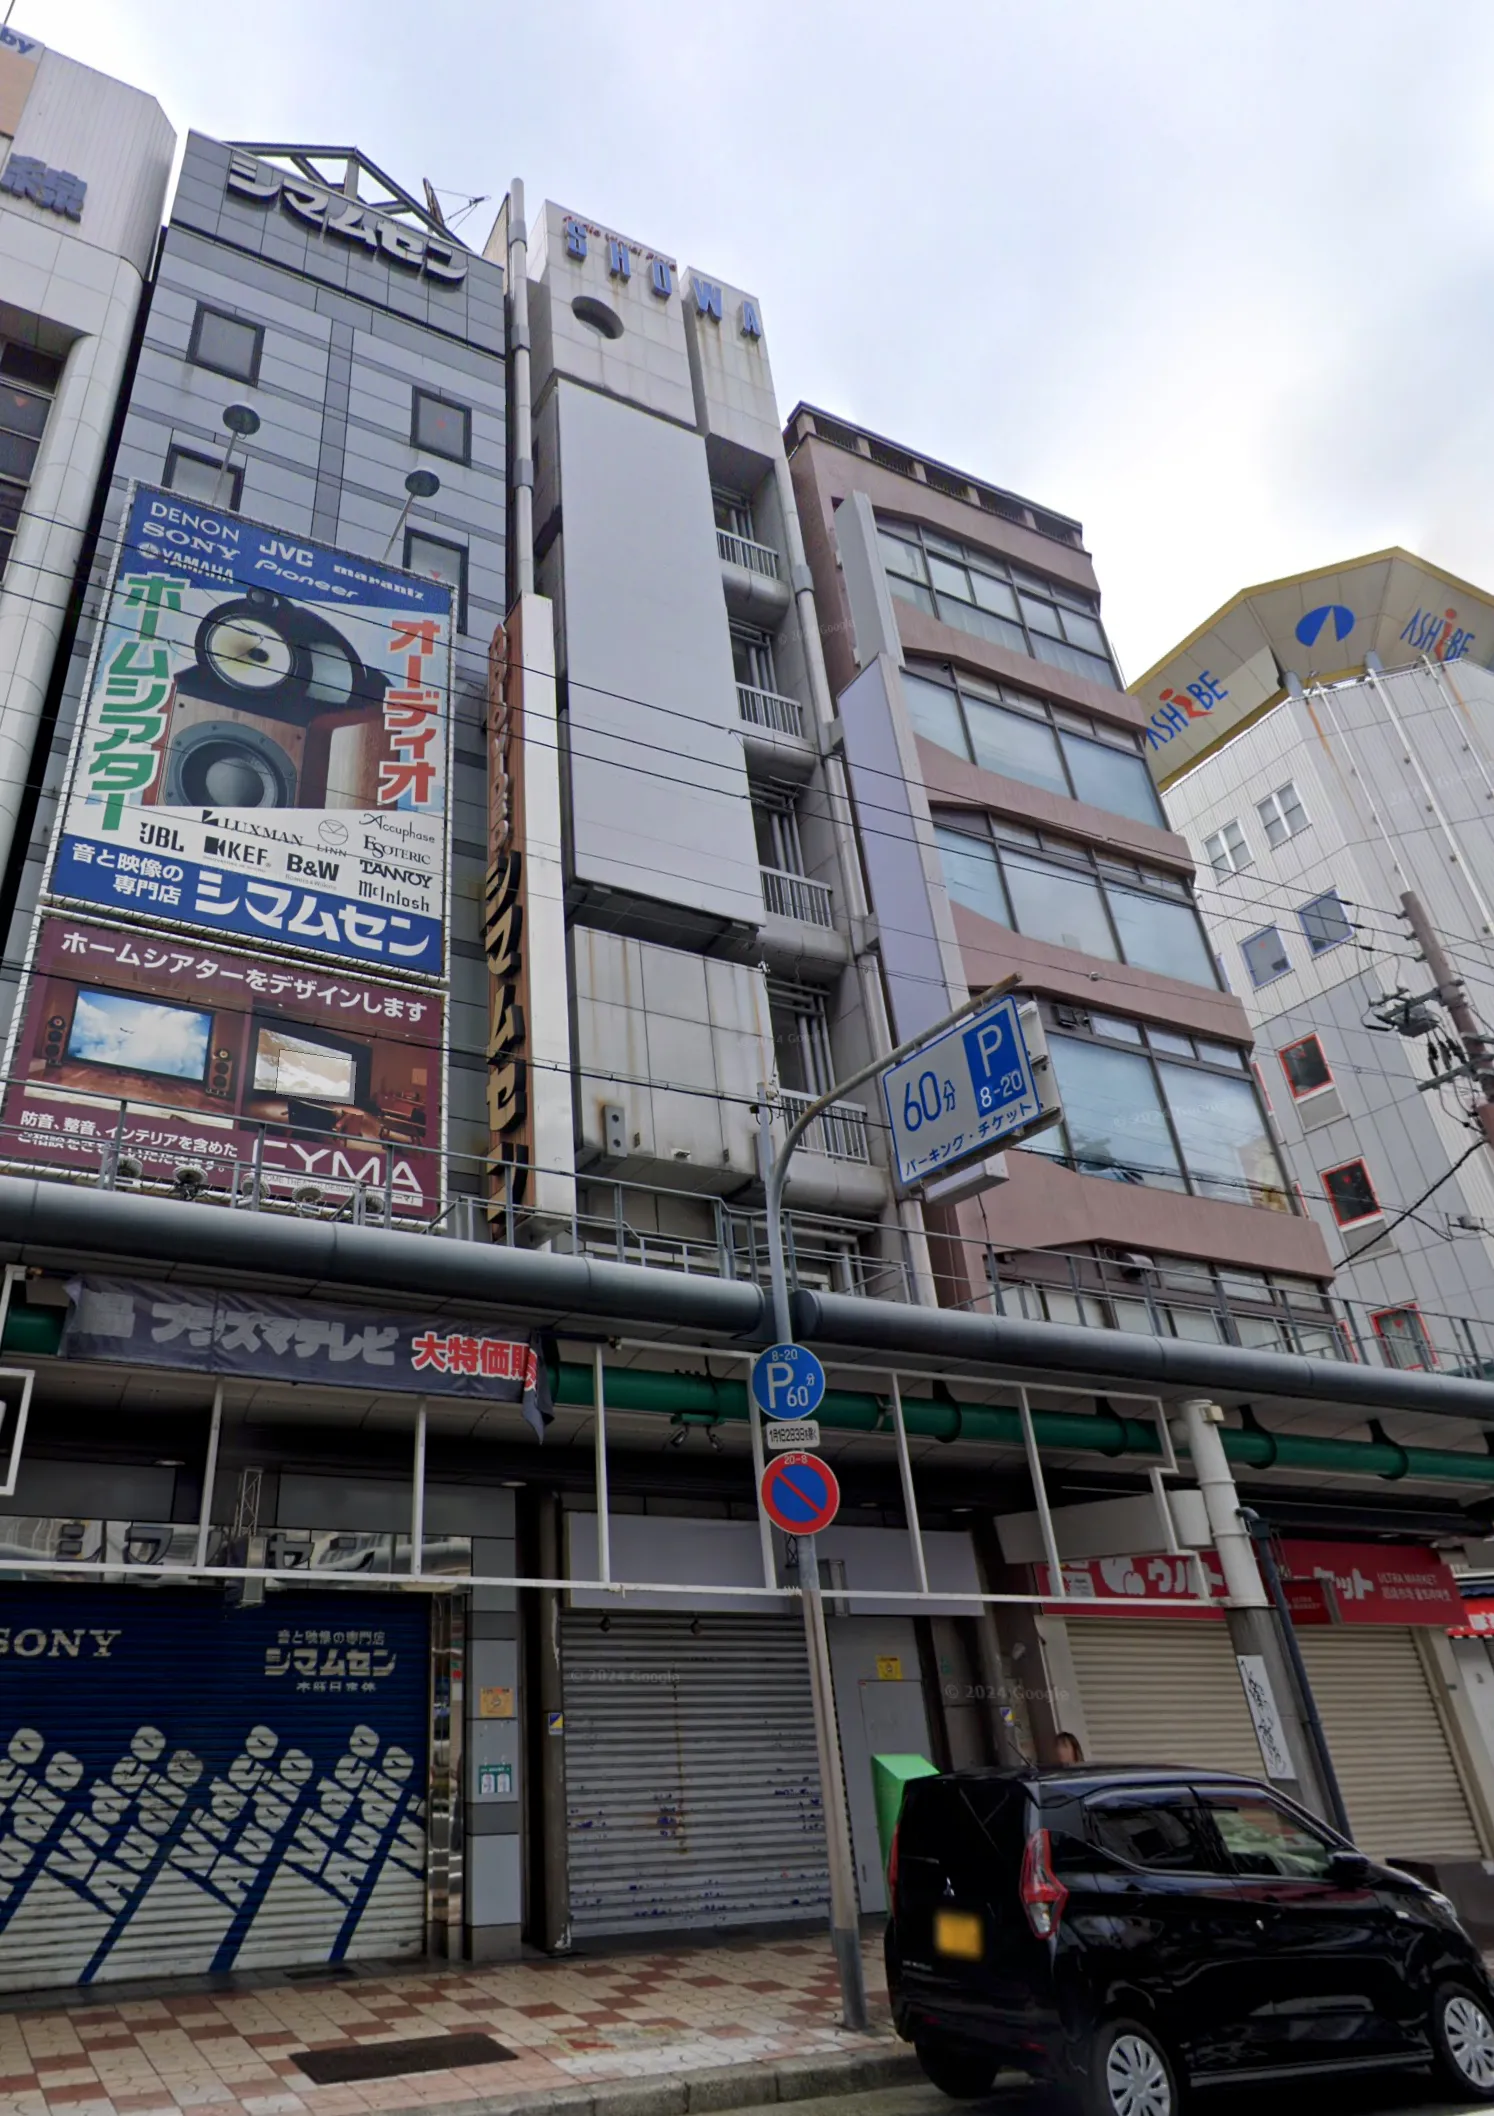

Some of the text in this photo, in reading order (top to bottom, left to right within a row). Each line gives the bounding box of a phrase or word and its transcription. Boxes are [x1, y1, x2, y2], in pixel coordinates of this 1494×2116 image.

[227, 154, 469, 283] シマムセン
[565, 218, 762, 341] SHOWA
[142, 521, 241, 561] SONY
[150, 501, 240, 544] DENON
[162, 548, 234, 584] YAMAHA
[259, 540, 314, 568] JVC
[254, 559, 359, 598] Pioneer
[333, 564, 425, 600] marantz
[88, 573, 188, 832] ホームシアター
[379, 619, 441, 805] オーディオ
[140, 823, 185, 852] JBL
[225, 818, 304, 847] LUXMAN
[359, 813, 436, 844] Accuphase
[73, 843, 184, 882] 音と映像の
[227, 838, 269, 866] KEF
[287, 852, 340, 882] B&W
[316, 844, 348, 858] LINN
[113, 874, 182, 905] 専門店
[360, 859, 433, 889] TANNOY
[195, 869, 430, 957] シマムセン
[359, 880, 430, 913] McIntosh
[61, 932, 428, 1022] ホームシアターをデザインします
[977, 1024, 1003, 1078] P
[903, 1071, 956, 1132] 60分
[980, 1070, 1023, 1108] 8-20
[20, 1110, 239, 1158] 防音、整音、インテリアを含めた
[906, 1102, 1032, 1177] パーキング・チケット
[771, 1348, 798, 1362] 8-20
[767, 1363, 794, 1409] P
[784, 1455, 808, 1465] 20-8
[264, 1647, 398, 1677] シマムセン
